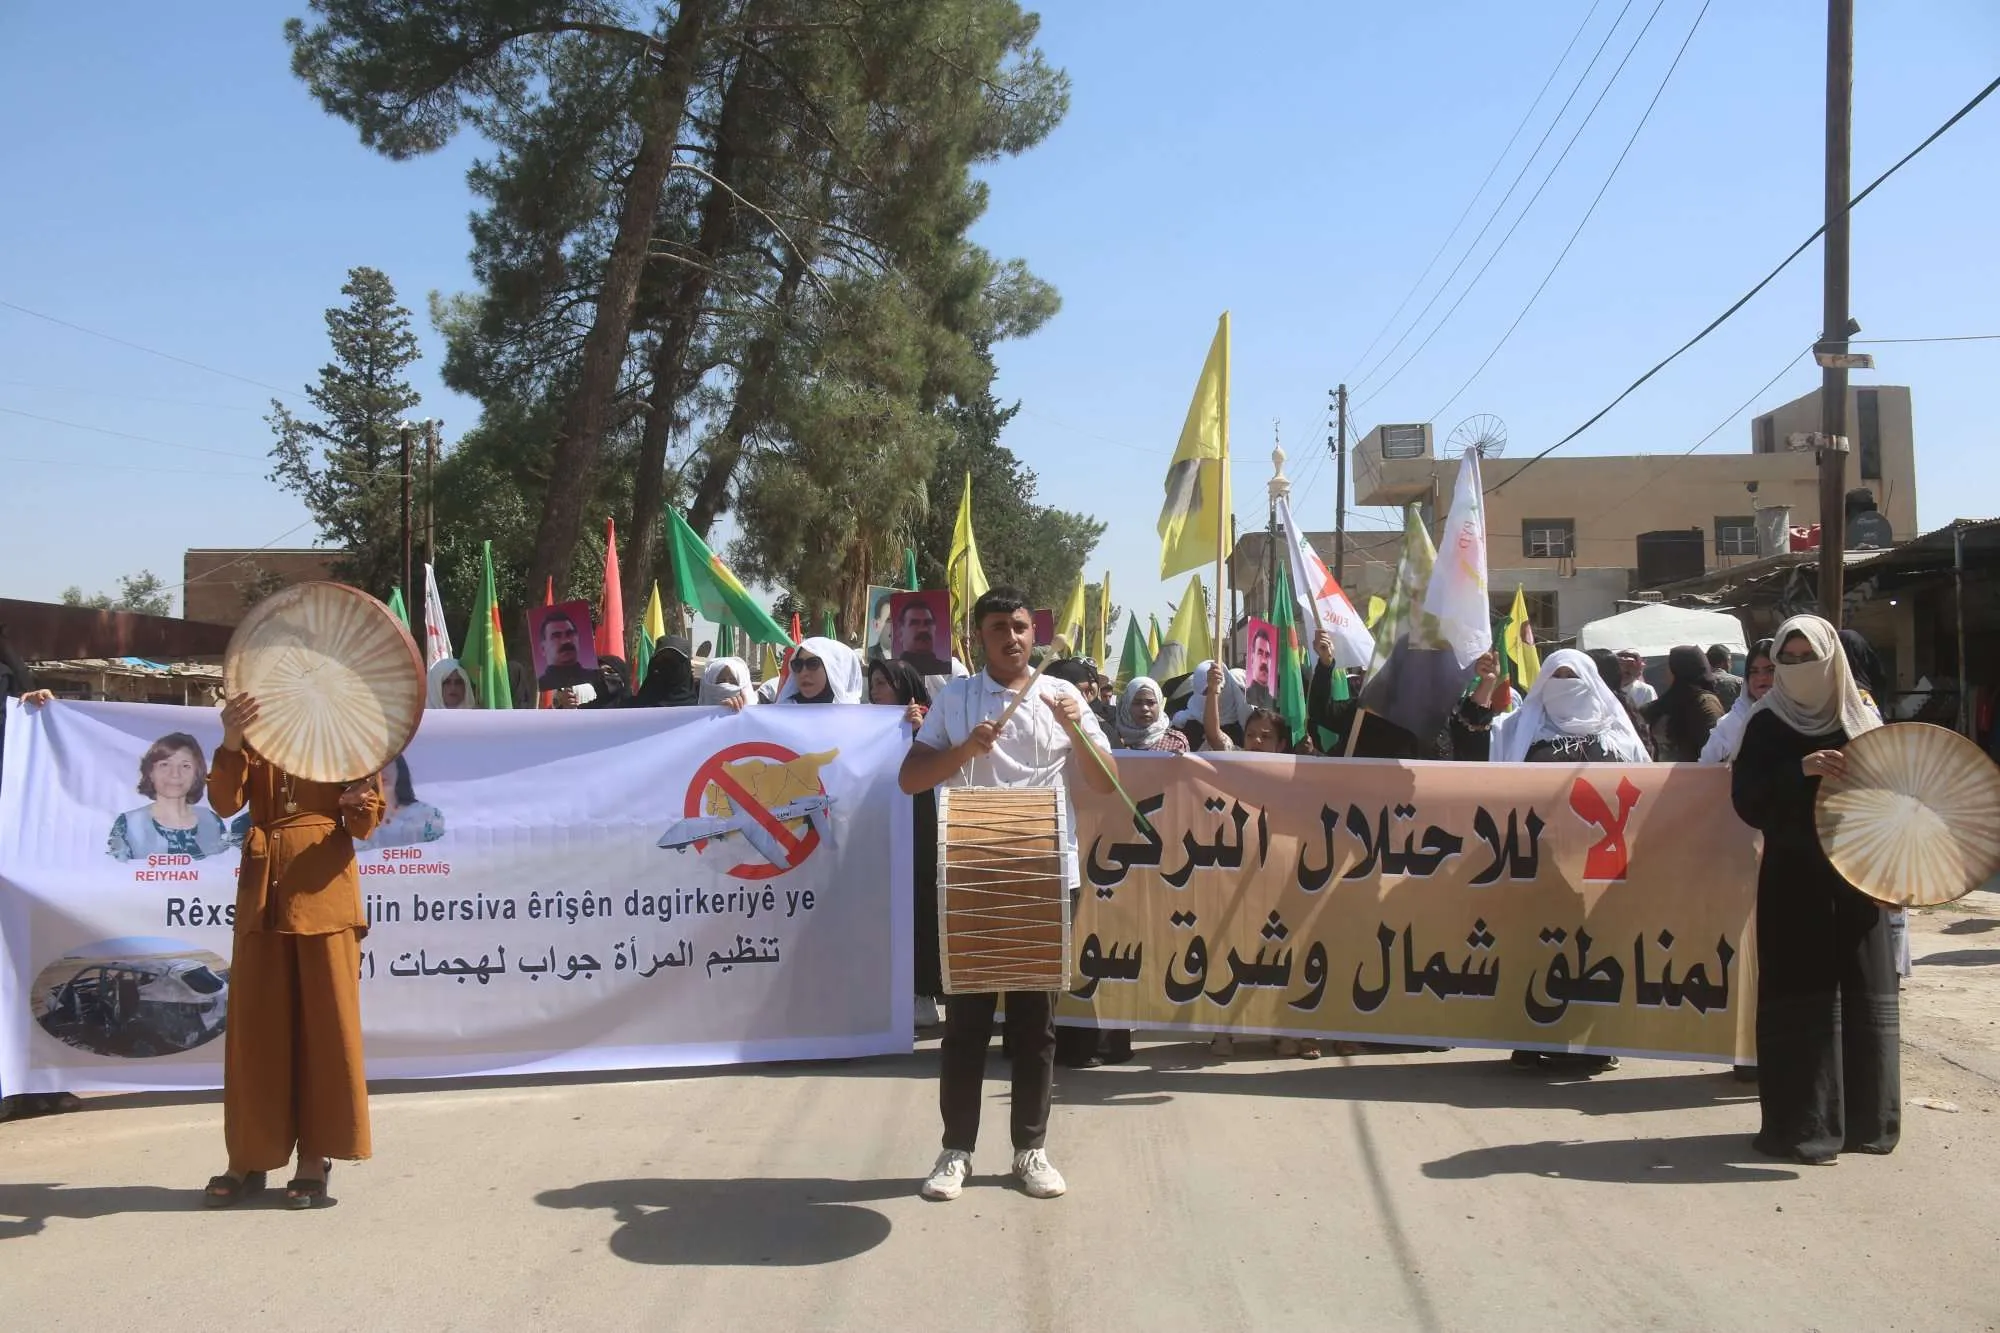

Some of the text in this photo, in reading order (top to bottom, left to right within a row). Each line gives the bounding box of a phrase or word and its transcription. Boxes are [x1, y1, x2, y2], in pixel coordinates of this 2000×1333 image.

[1323, 610, 1349, 628] 2003
[1086, 776, 1642, 900] لا للاحتلال التركي
[135, 870, 199, 881] REIYHAN
[358, 864, 396, 875] USRA
[366, 894, 400, 930] jin
[414, 892, 516, 922] bersiva
[528, 889, 612, 925] êrîşên
[624, 883, 776, 922] dagirkeriyê
[786, 889, 815, 917] ye
[390, 944, 506, 985] لهجمات
[518, 945, 602, 981] جواب
[614, 935, 694, 978] المرأة
[705, 934, 780, 979] تنظيم
[1164, 910, 1329, 1010] وشرق
[1352, 917, 1499, 1012] شمال
[1525, 926, 1735, 1024] لمناطق
